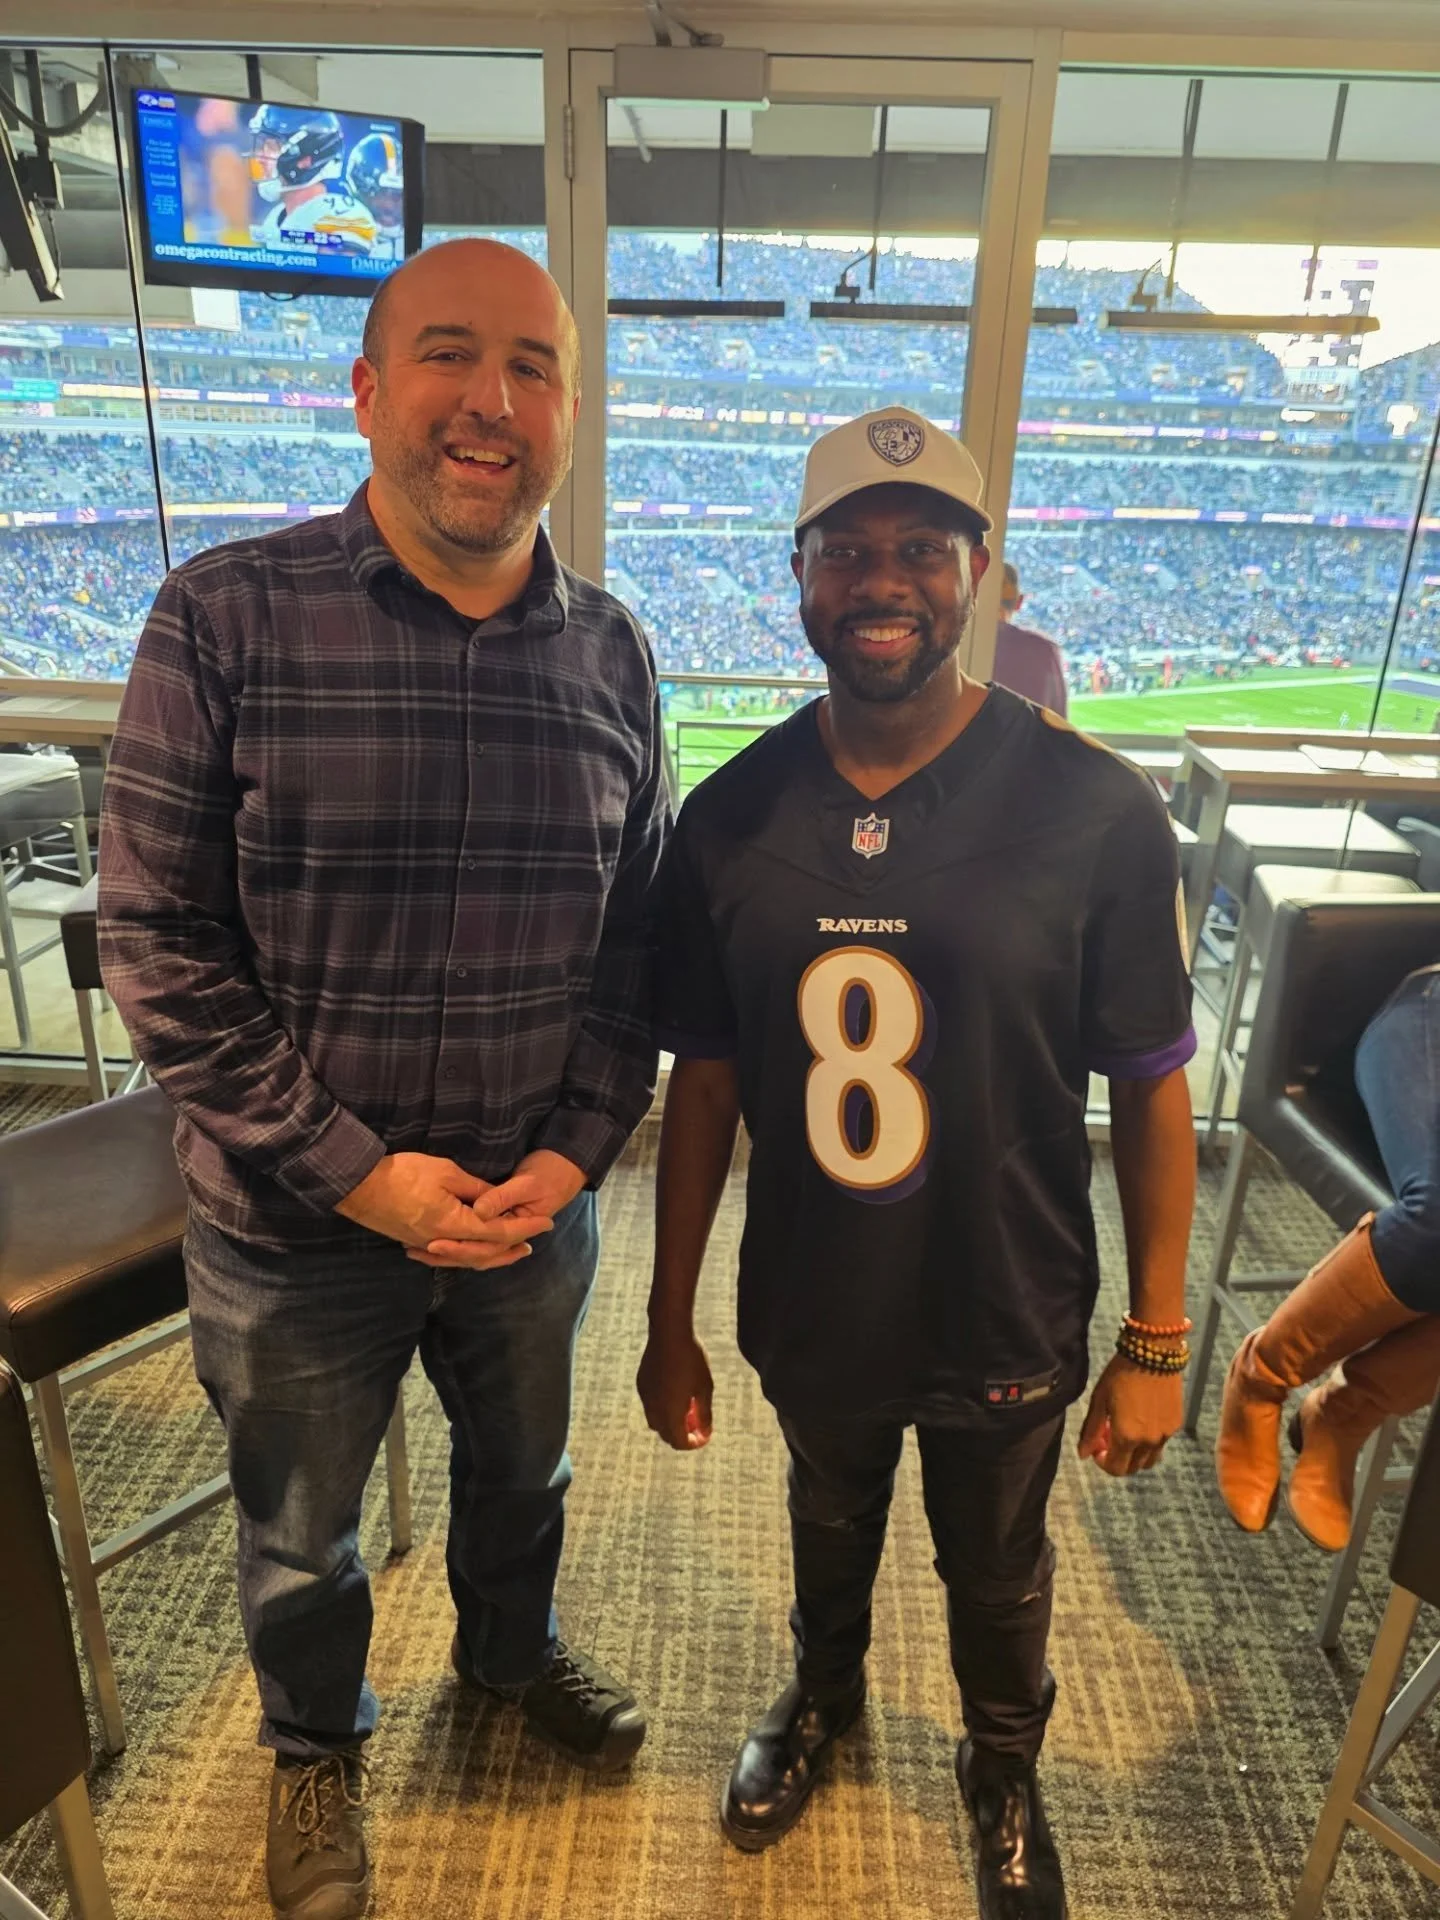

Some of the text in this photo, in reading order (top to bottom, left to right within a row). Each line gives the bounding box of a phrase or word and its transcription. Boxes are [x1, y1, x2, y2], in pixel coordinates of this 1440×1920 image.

[155, 242, 317, 268] omegacontracting.com
[857, 833, 881, 850] NFL
[816, 917, 908, 935] RAVENS
[797, 945, 934, 1196] 8
